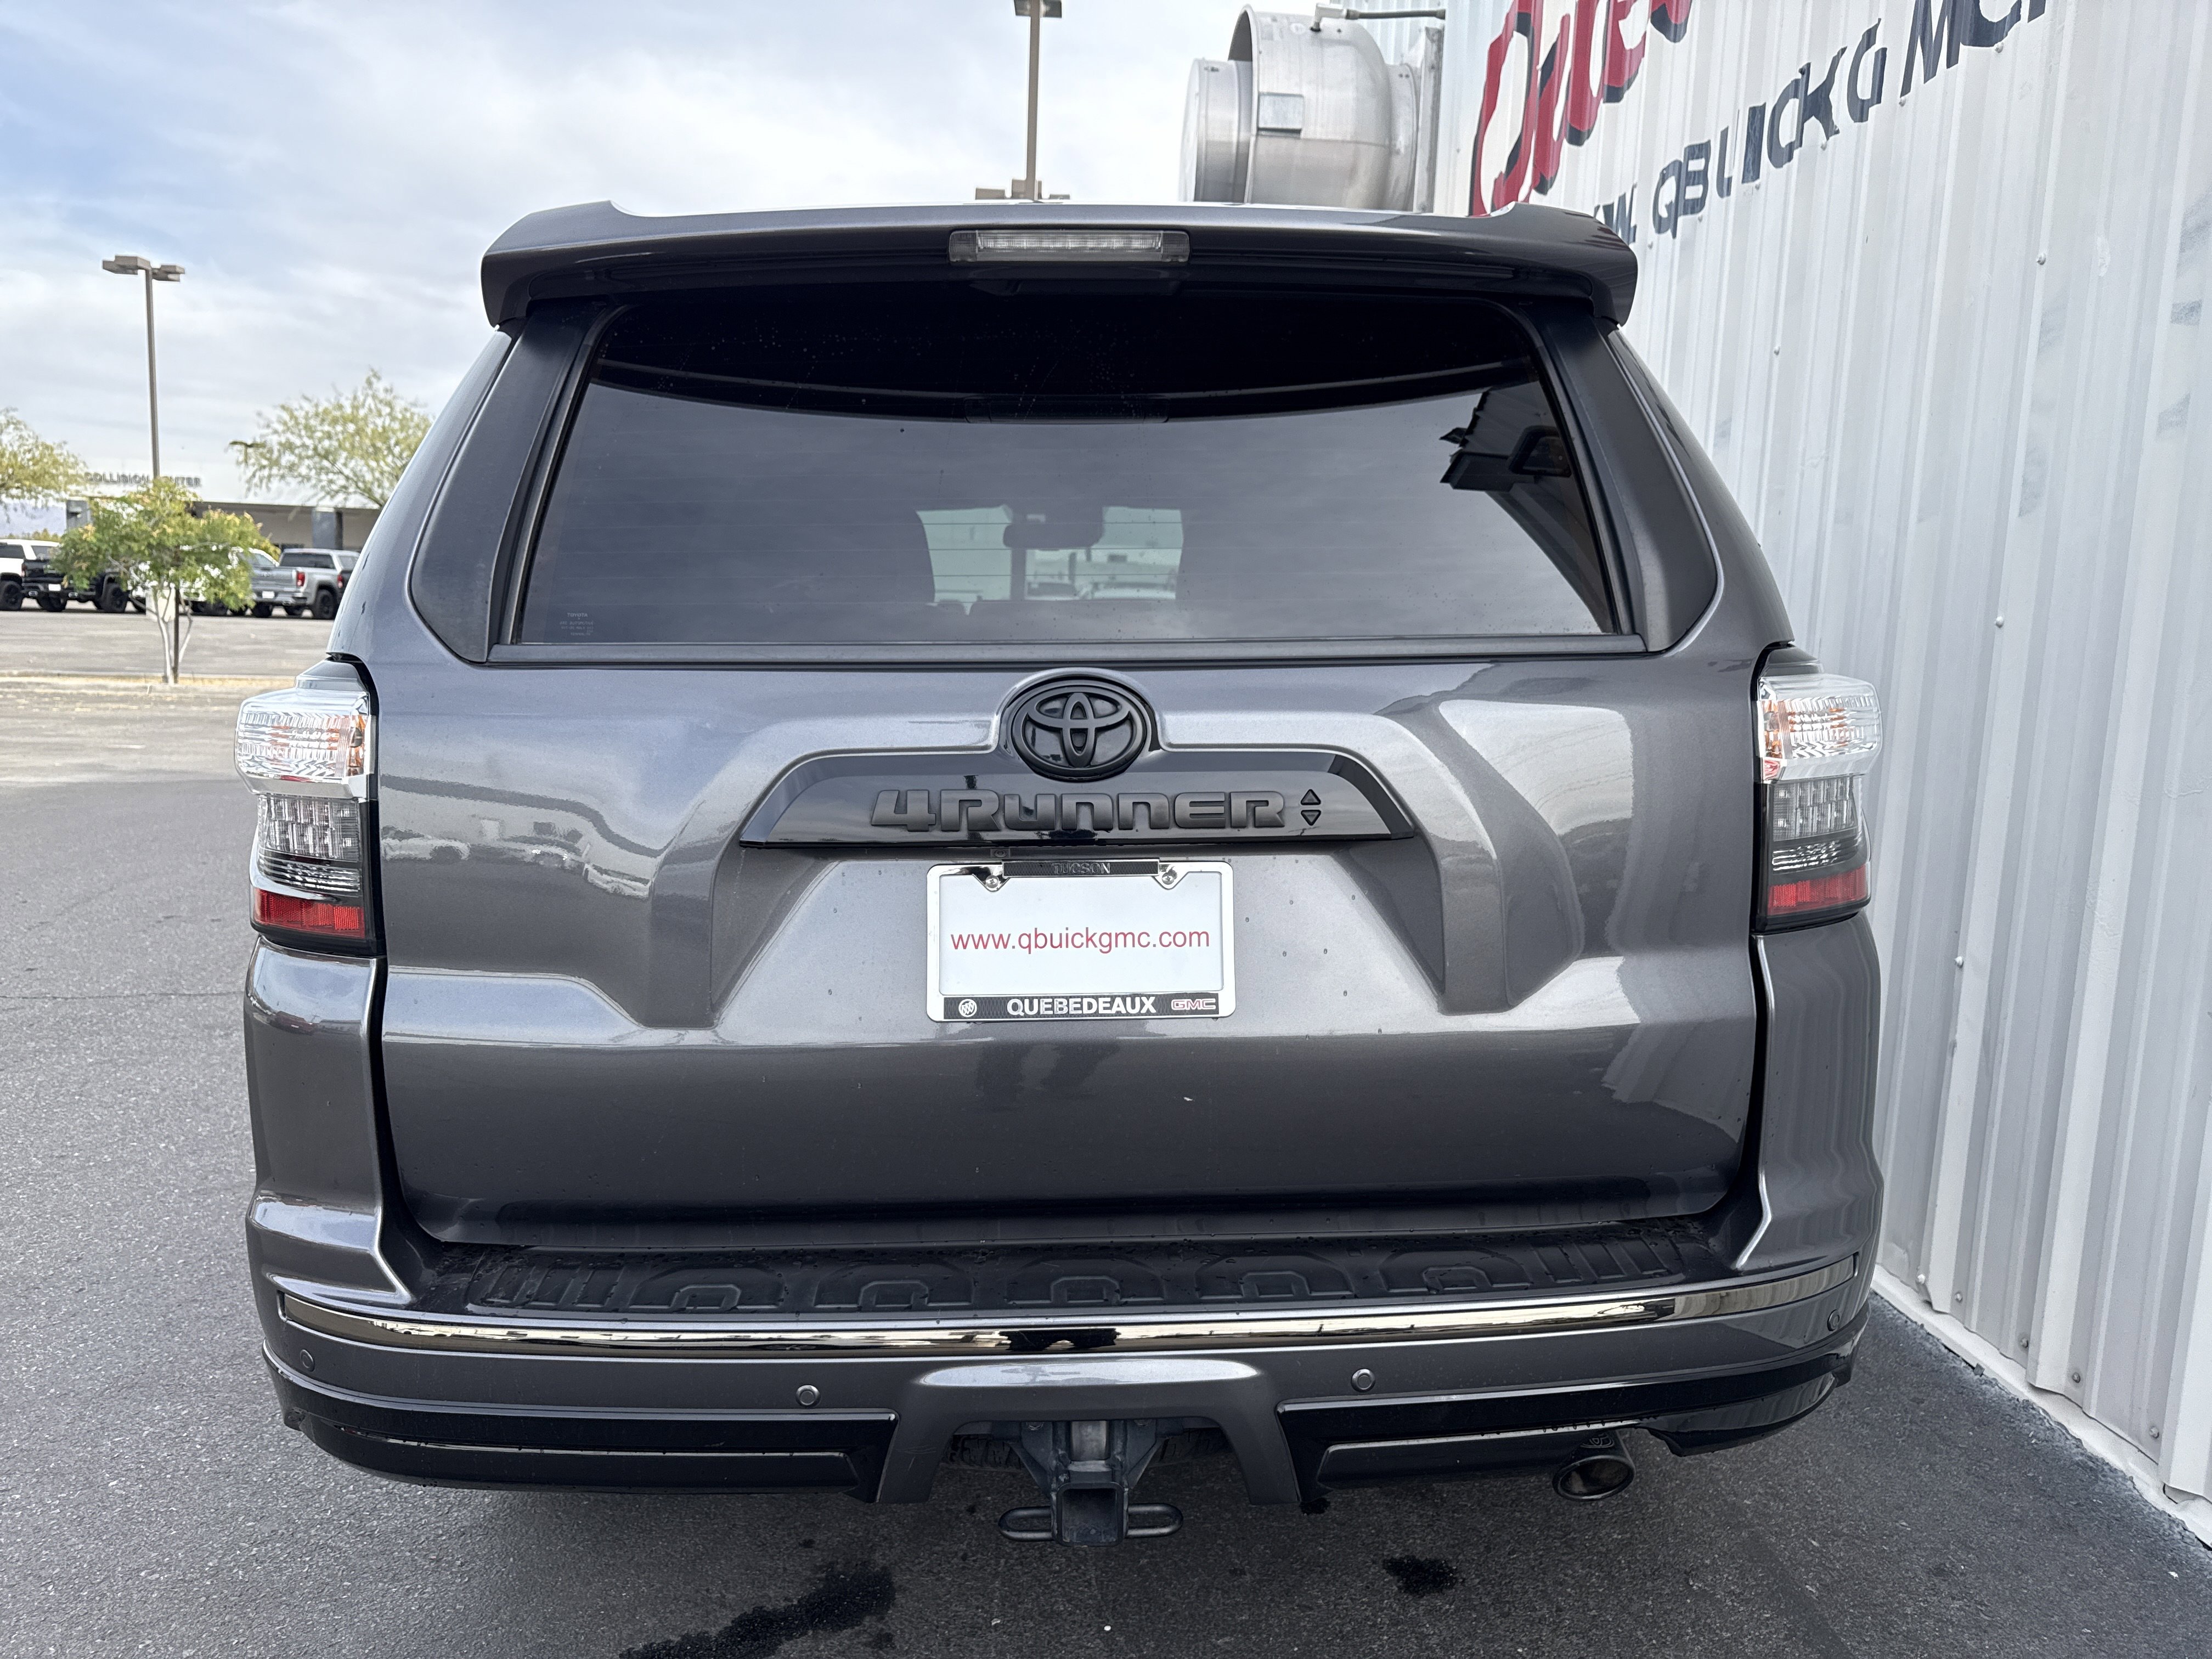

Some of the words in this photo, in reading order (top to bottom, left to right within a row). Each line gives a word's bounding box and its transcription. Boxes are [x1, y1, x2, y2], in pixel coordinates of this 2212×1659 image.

[1467, 0, 1694, 216] Que
[84, 472, 149, 486] COLLISION
[1052, 862, 1110, 874] TUCSON
[951, 927, 1209, 954] www.qbuickgmc.com
[1007, 997, 1157, 1015] QUEBEDEAUX
[1171, 998, 1217, 1011] GMC
